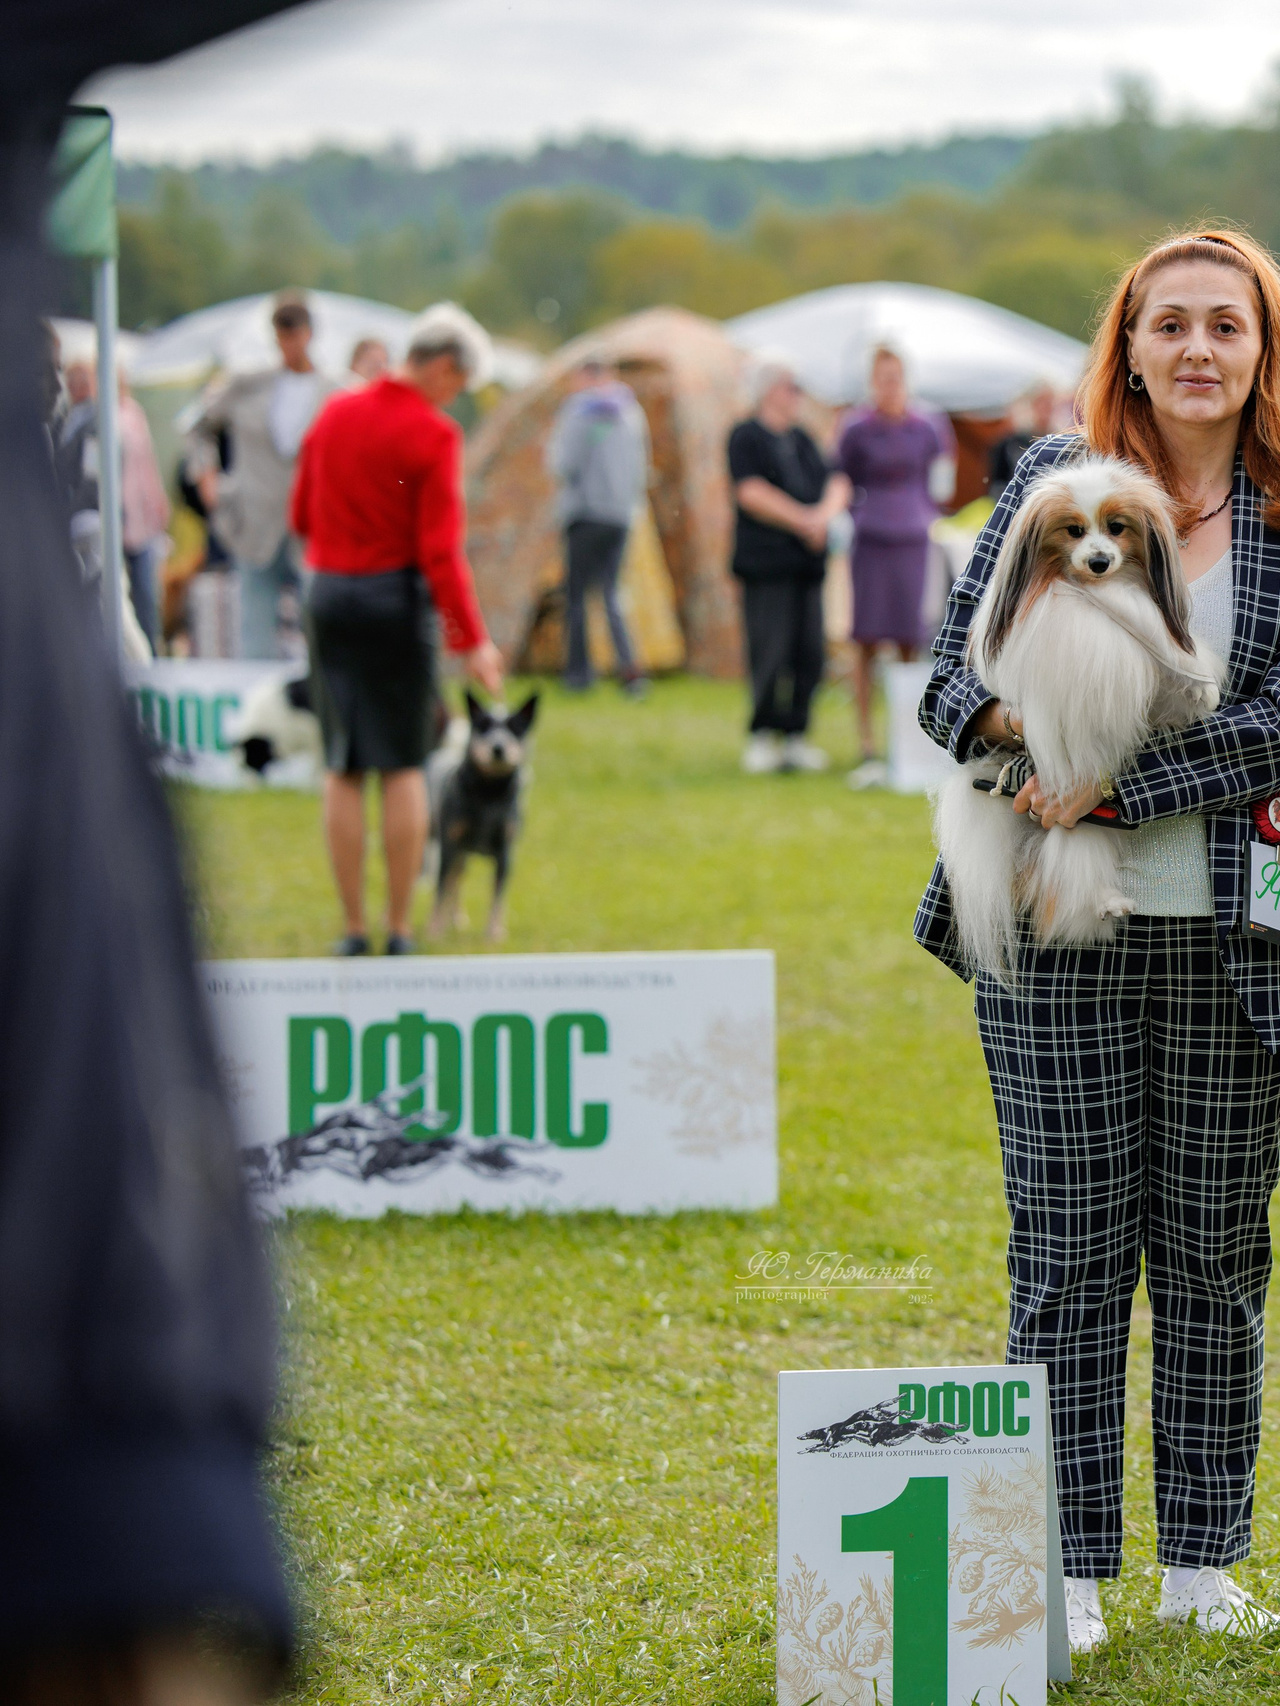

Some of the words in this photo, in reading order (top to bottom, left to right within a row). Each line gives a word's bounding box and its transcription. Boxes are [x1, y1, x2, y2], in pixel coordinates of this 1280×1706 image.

[899, 1380, 1030, 1438] РФОС
[829, 1450, 884, 1459] ФЕДЕРАЦИЯ
[885, 1448, 952, 1458] ОХОТНИЧЬЕГО
[953, 1446, 1031, 1456] СОБАКОВОДСТВА
[841, 1476, 948, 1706] 1
